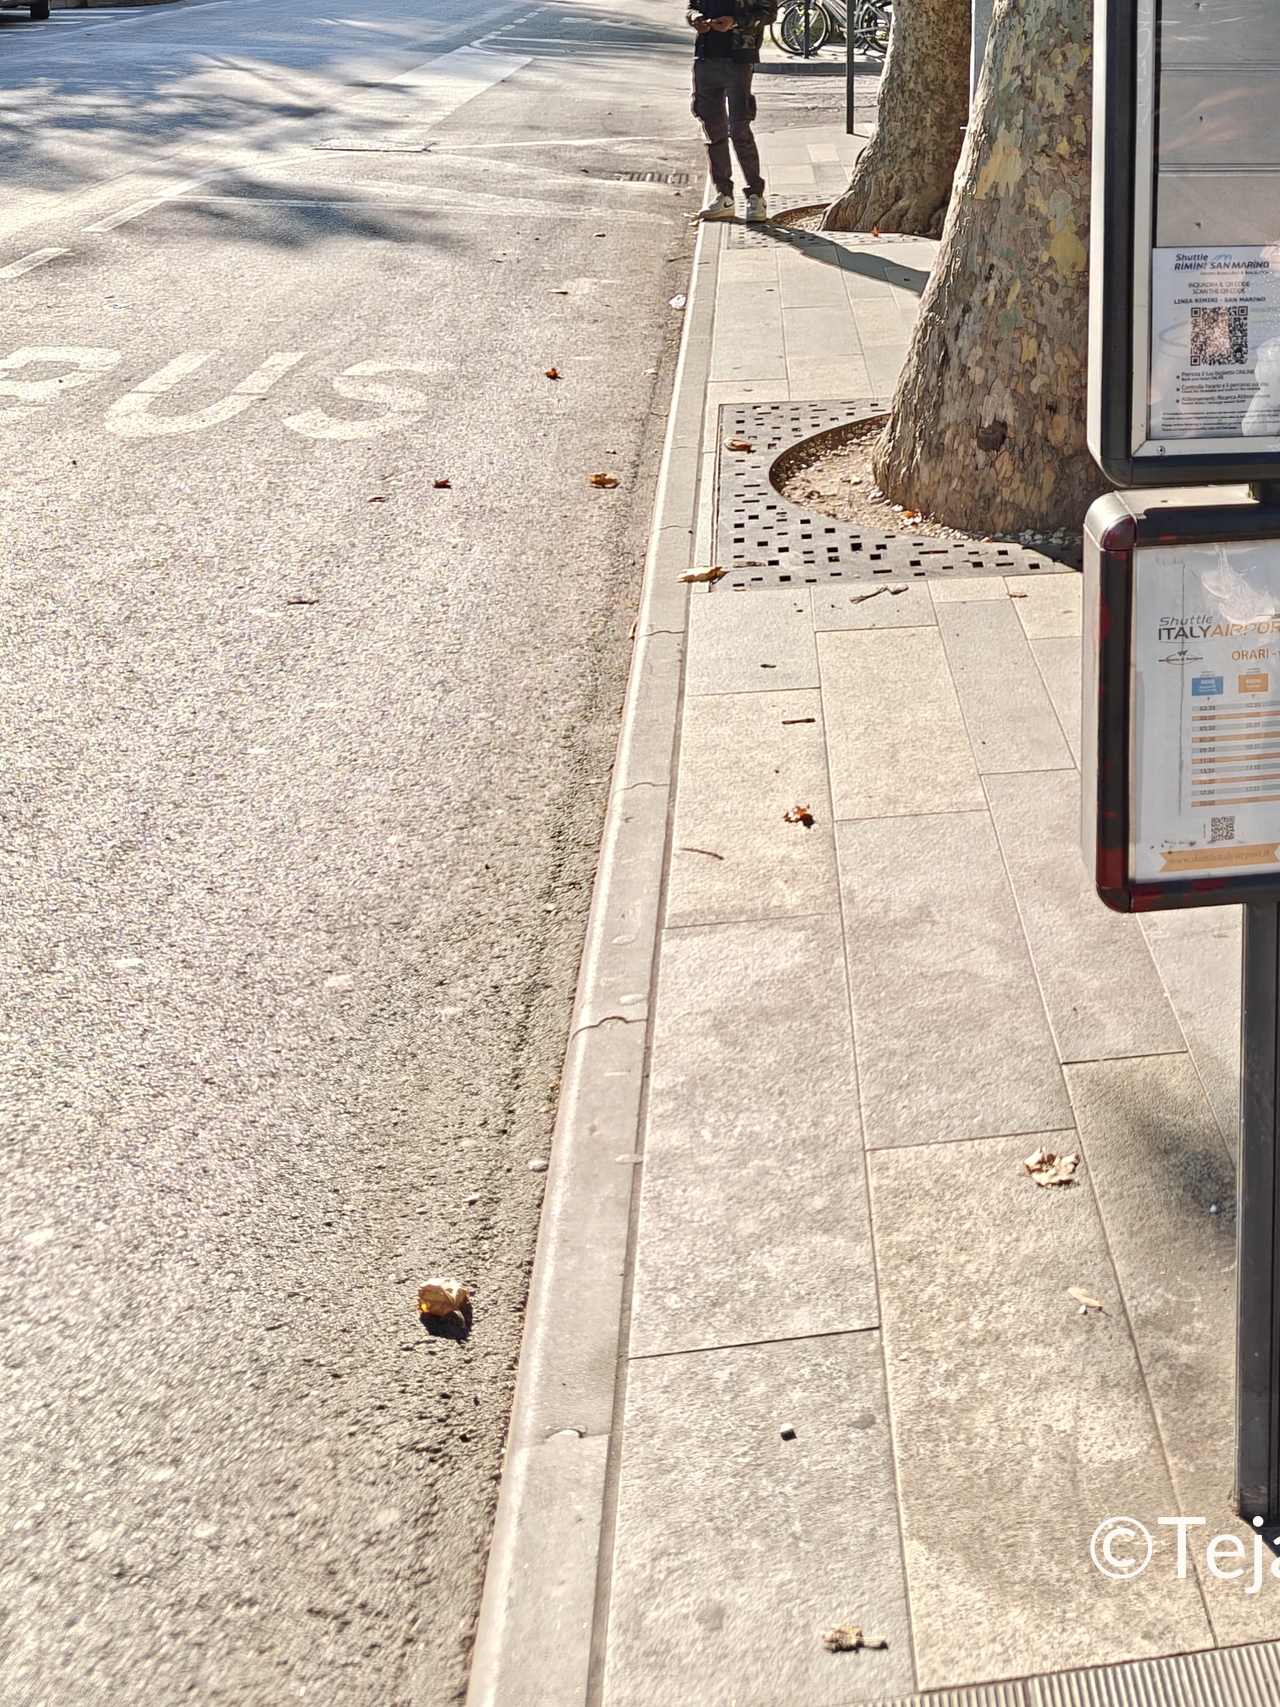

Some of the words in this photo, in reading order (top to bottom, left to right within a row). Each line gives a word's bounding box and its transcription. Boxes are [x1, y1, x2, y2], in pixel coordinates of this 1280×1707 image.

[1176, 253, 1208, 262] Shuttle
[1231, 261, 1270, 269] MARINO
[1159, 614, 1213, 626] Shuttle
[1231, 648, 1269, 661] ORARI
